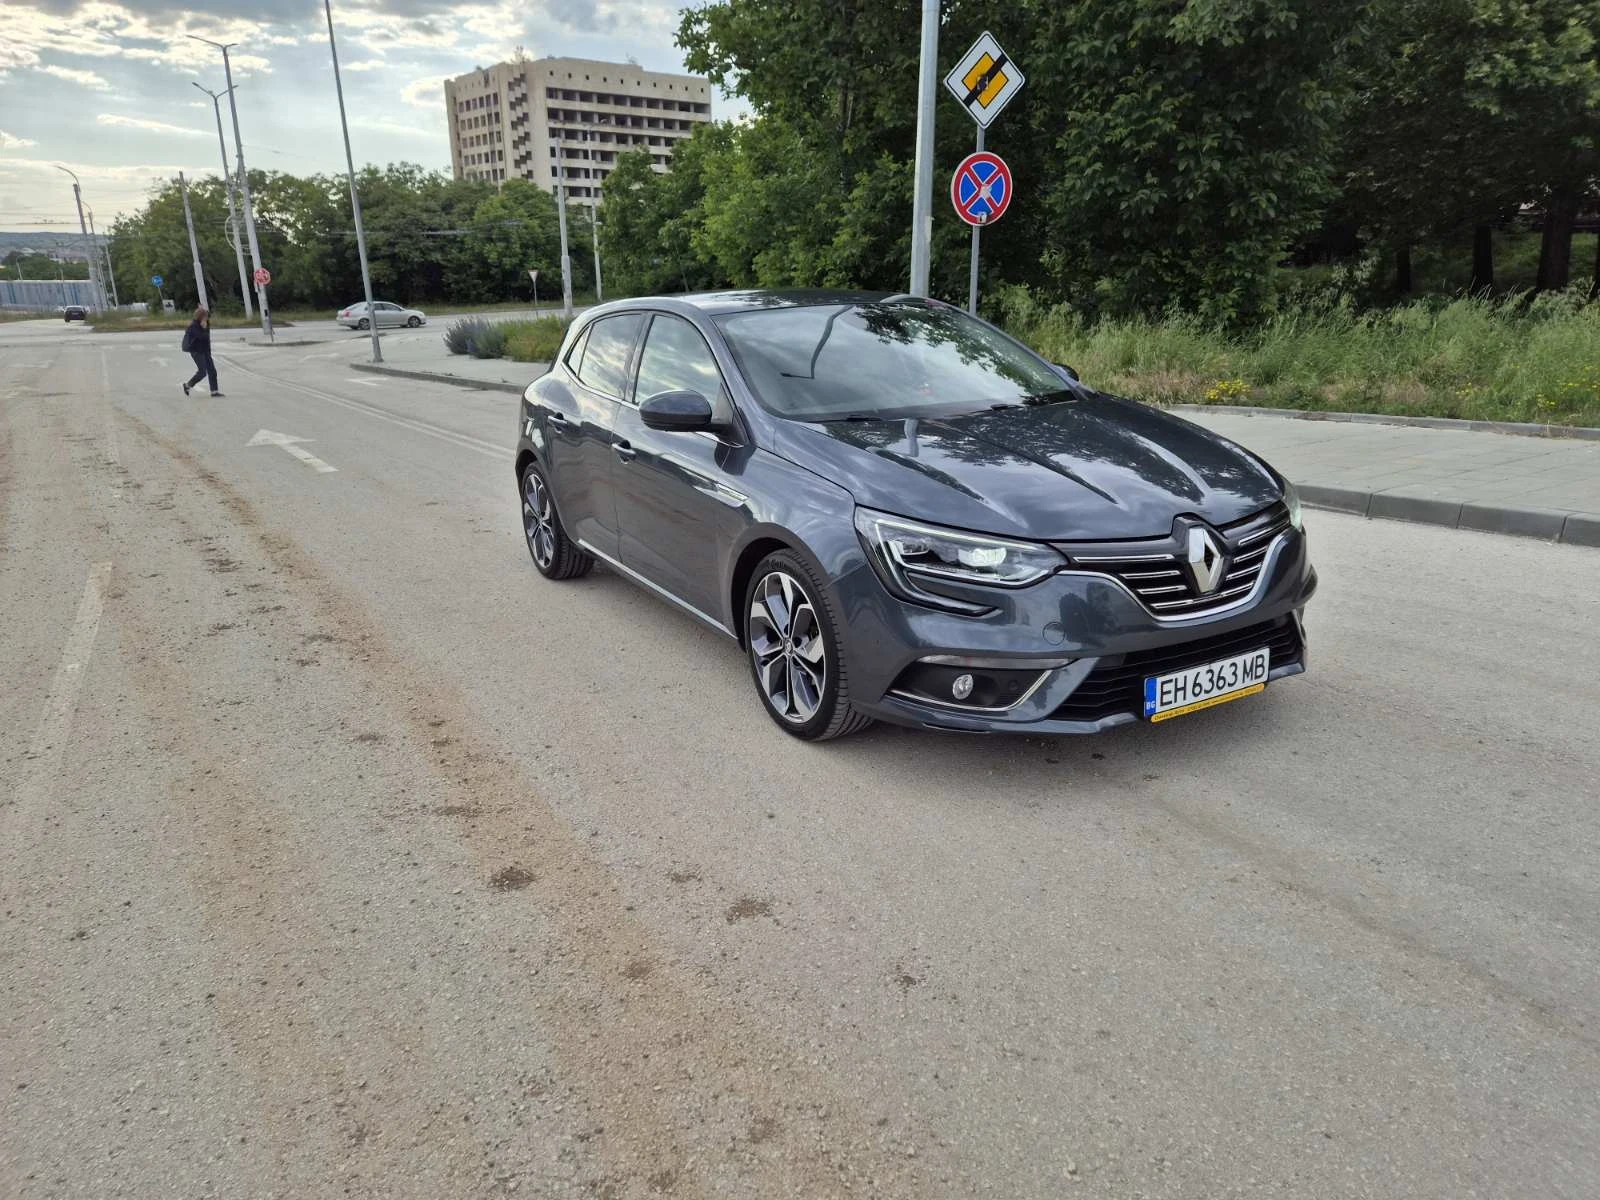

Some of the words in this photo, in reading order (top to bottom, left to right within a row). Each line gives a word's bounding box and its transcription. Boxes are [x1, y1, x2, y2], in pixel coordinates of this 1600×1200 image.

[1160, 675, 1187, 706] EH
[1191, 662, 1238, 698] 6363
[1242, 654, 1265, 684] MB
[1146, 701, 1156, 710] BG
